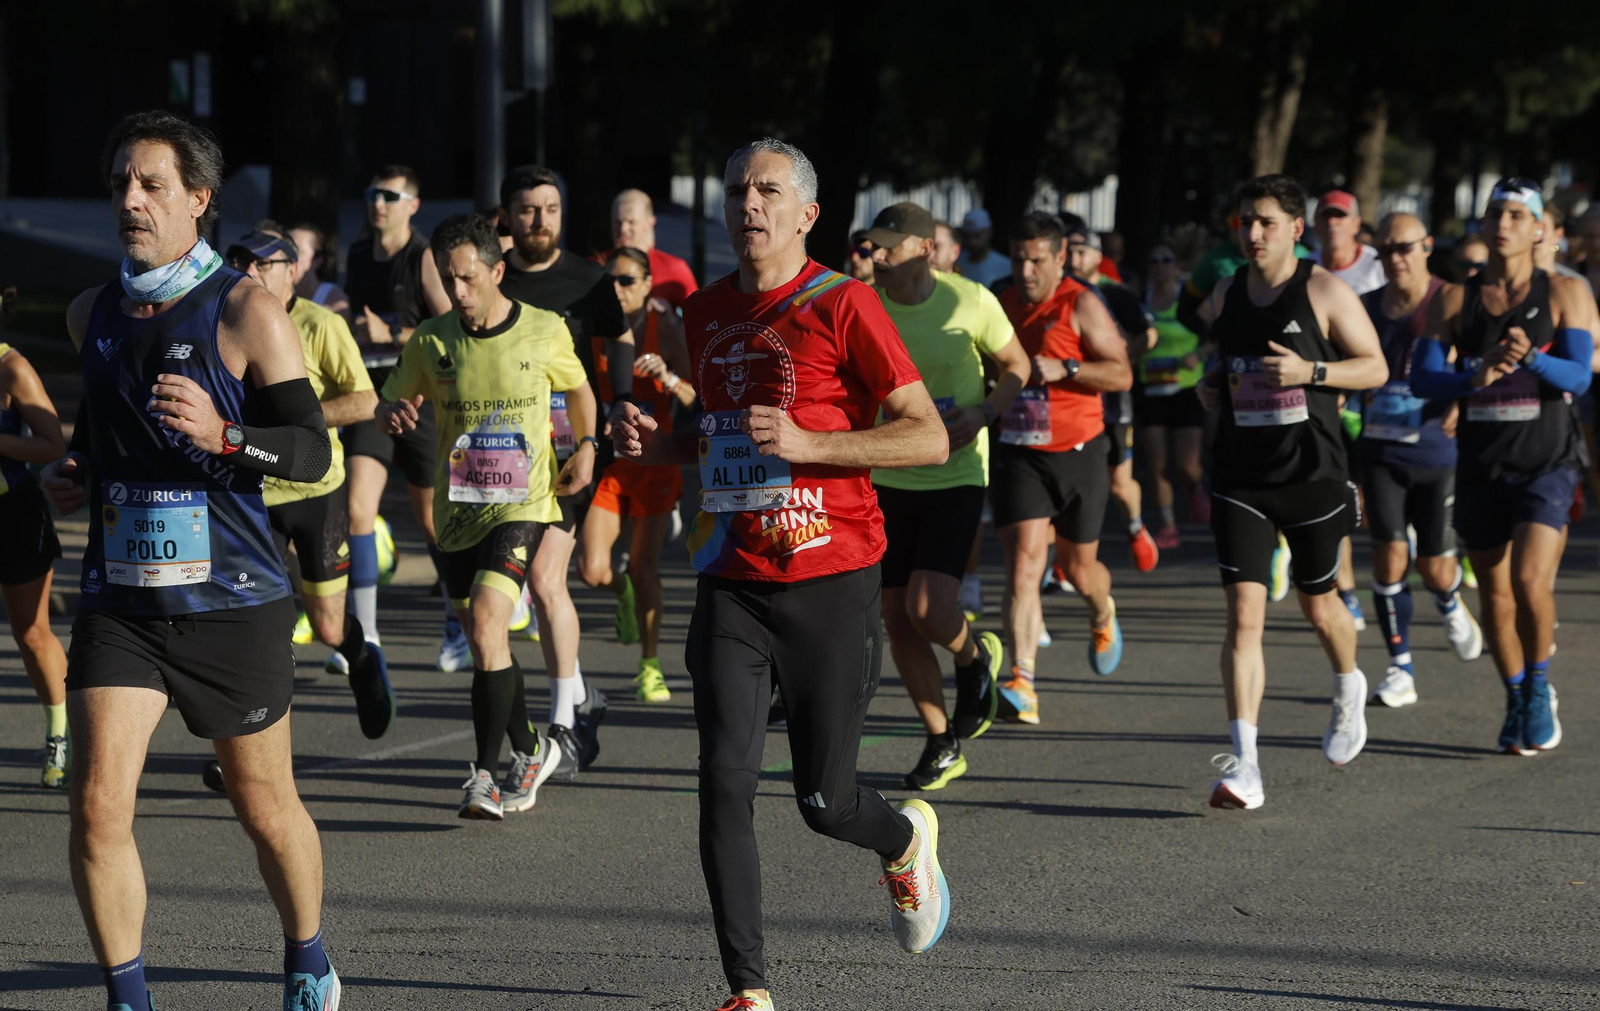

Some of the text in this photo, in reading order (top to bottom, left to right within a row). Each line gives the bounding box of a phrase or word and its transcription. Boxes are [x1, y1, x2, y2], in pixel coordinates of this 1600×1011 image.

[442, 399, 480, 412] MIGOS
[484, 395, 538, 411] PIRÁMIDE
[455, 413, 524, 426] MIRAFLORES
[475, 437, 518, 447] ZURICH
[244, 444, 279, 464] KIPRUN
[724, 446, 751, 459] 6864
[477, 458, 499, 467] 8857
[466, 472, 512, 485] ACEDO
[712, 465, 767, 486] AL LIO
[132, 489, 192, 502] ZURICH
[134, 520, 165, 533] 5019
[761, 509, 828, 534] NING
[761, 518, 833, 551] Team
[127, 539, 177, 560] POLO
[233, 581, 256, 590] ZURICH
